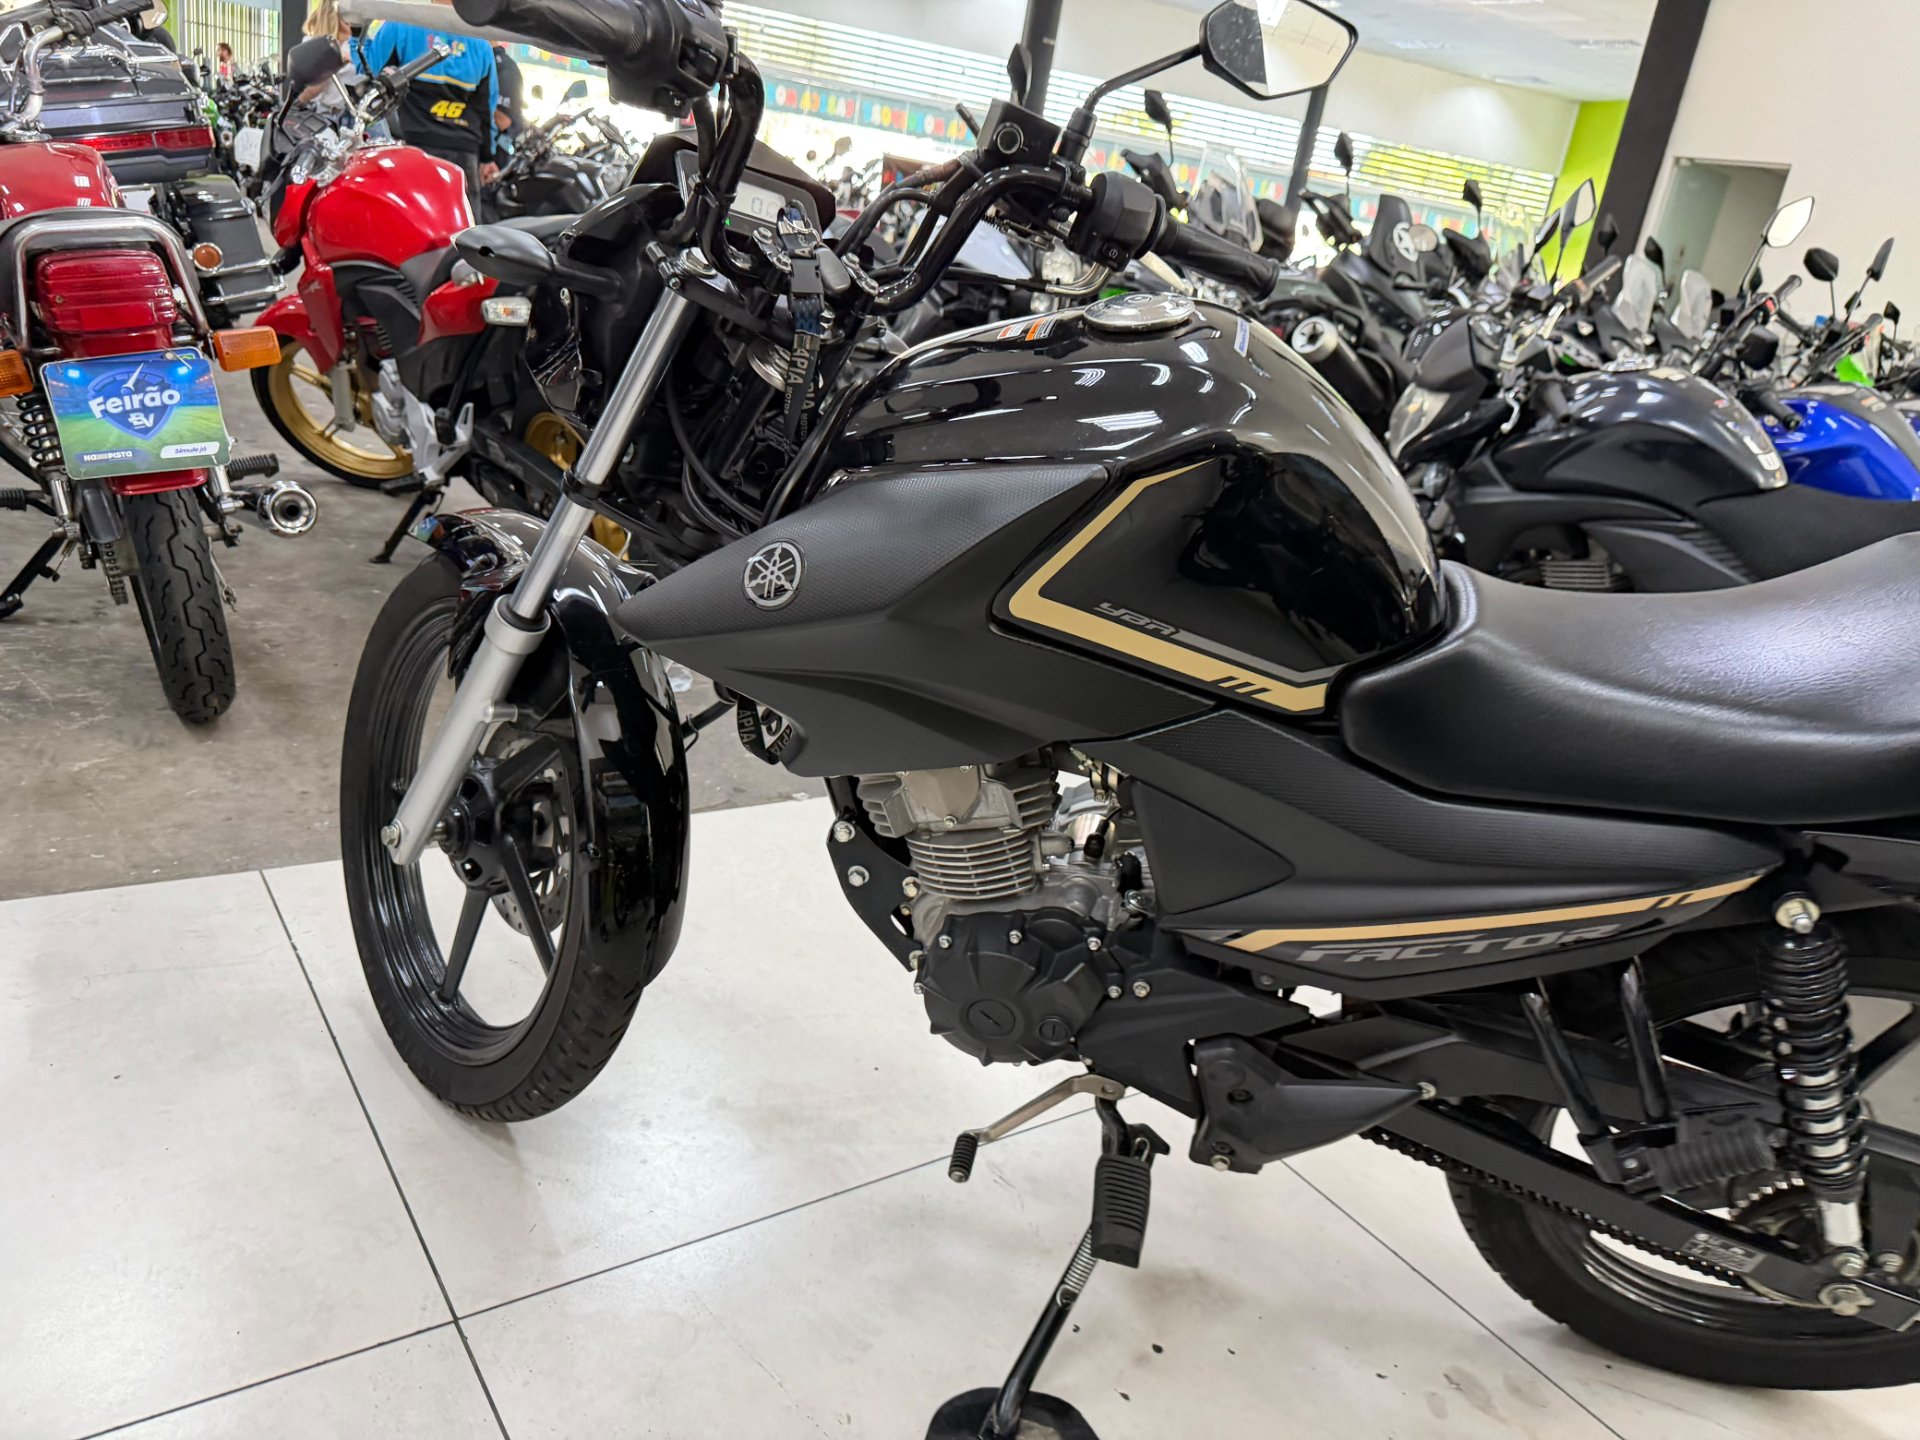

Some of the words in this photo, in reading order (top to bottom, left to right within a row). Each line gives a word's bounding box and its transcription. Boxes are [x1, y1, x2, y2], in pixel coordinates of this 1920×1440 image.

[430, 100, 466, 118] 46
[88, 386, 181, 419] Feirão
[1093, 602, 1177, 636] YBR
[1296, 923, 1622, 962] FACTOR
